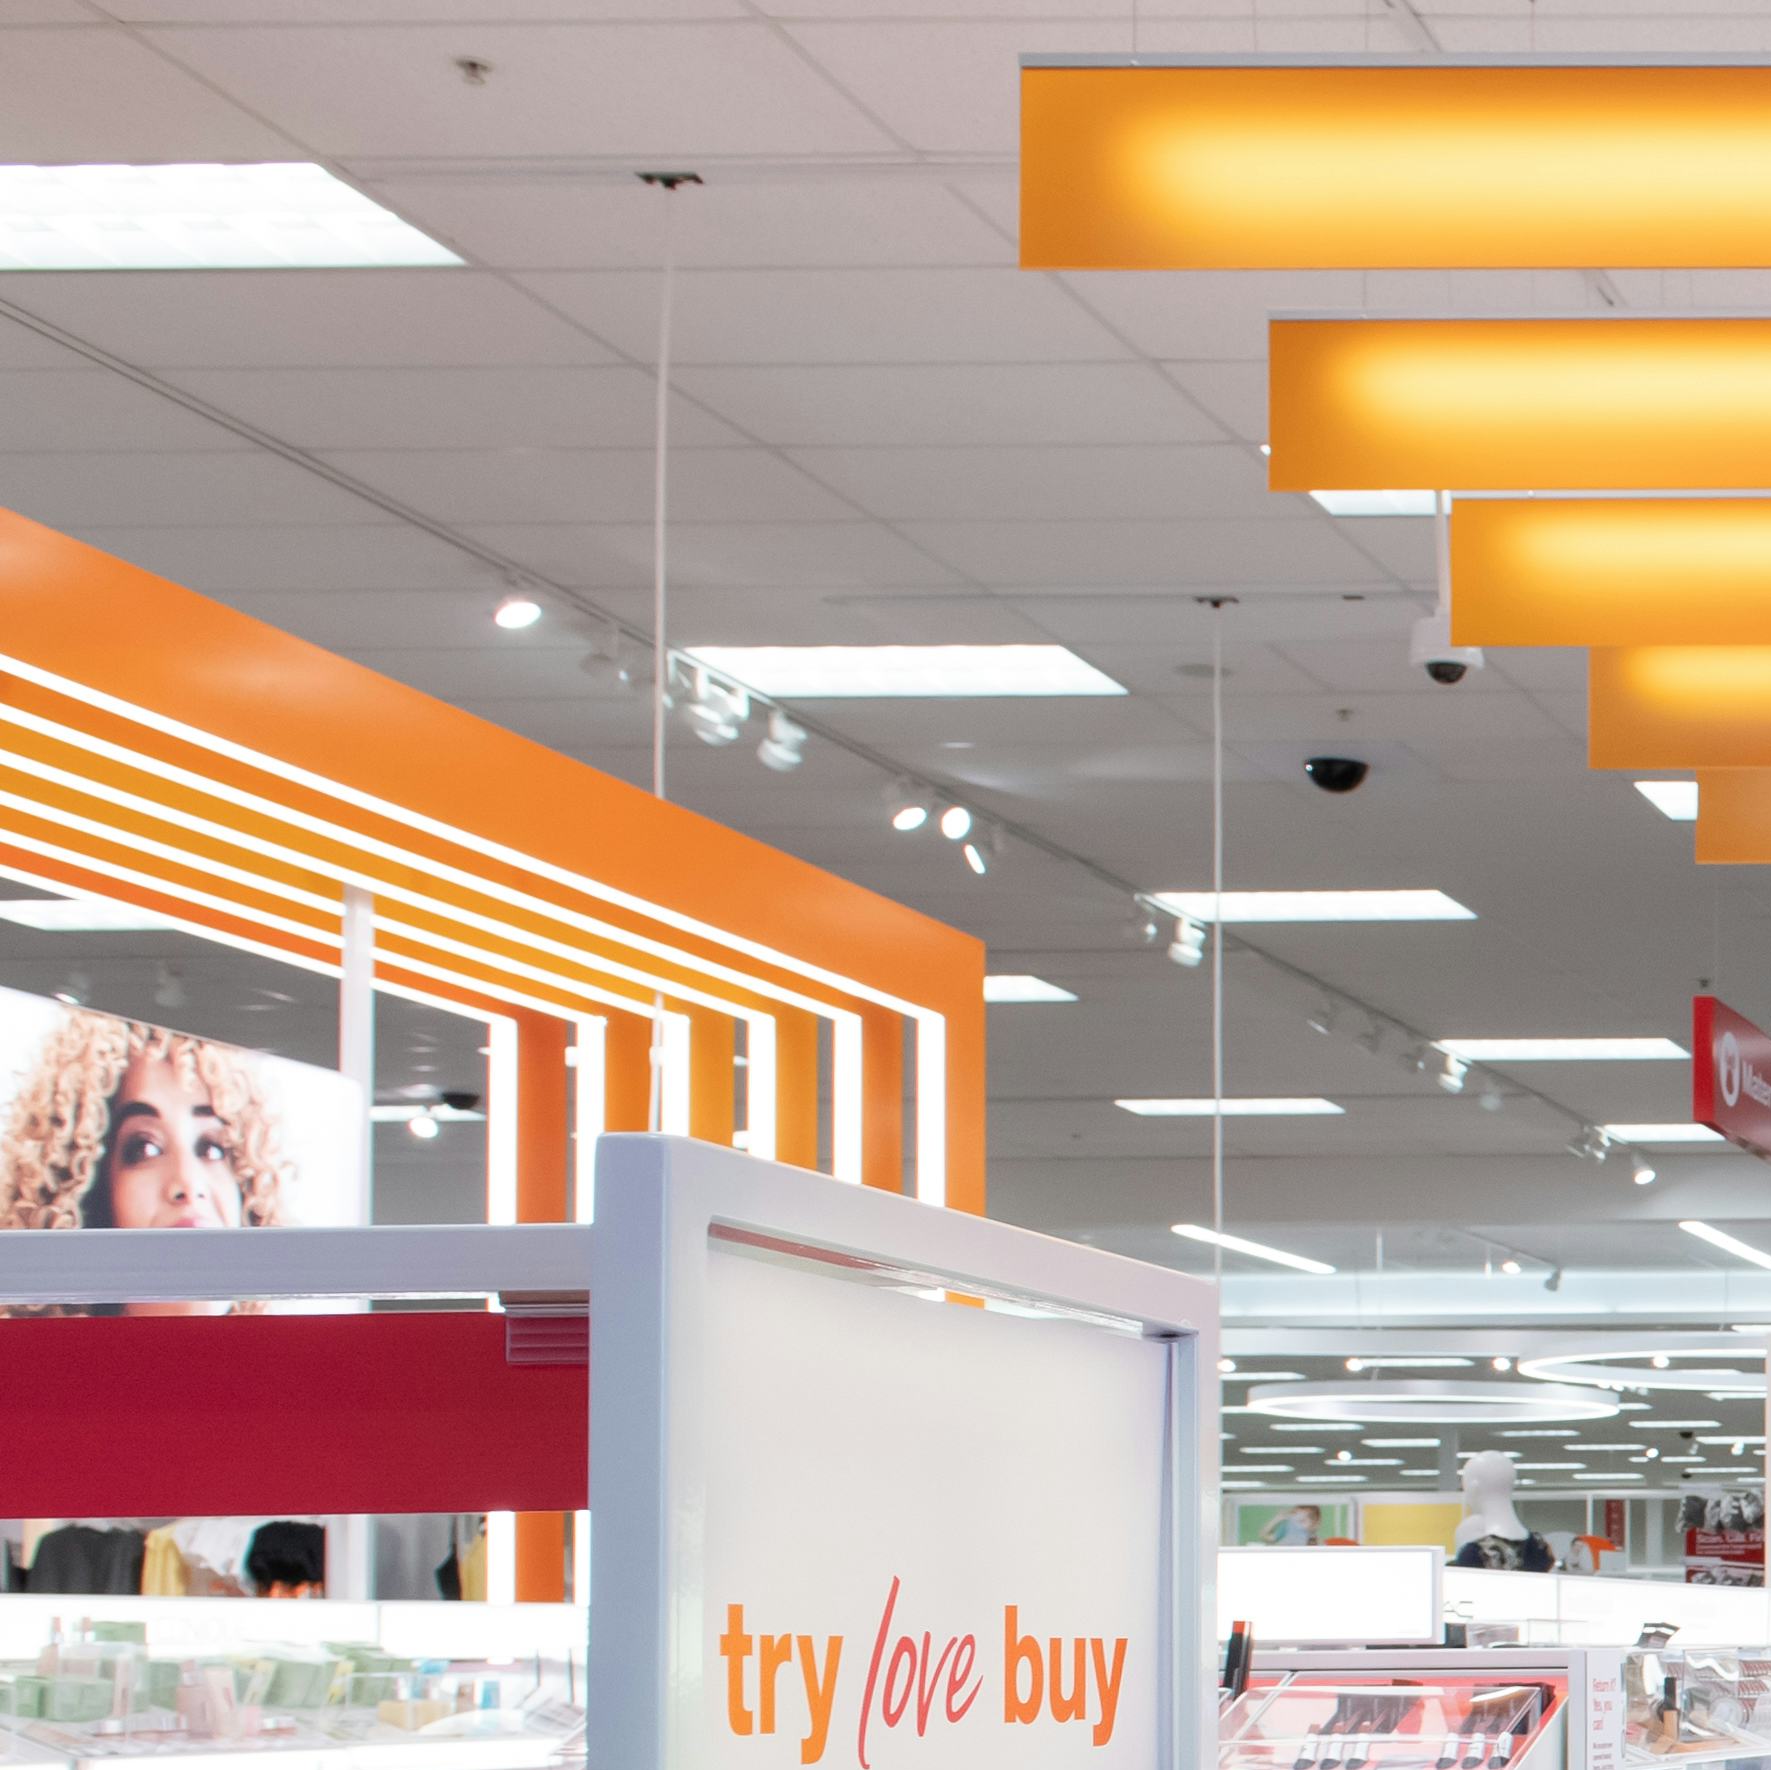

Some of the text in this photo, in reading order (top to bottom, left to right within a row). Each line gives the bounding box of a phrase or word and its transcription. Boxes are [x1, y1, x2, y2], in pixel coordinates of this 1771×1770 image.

[720, 1575, 1129, 1770] try love buy
